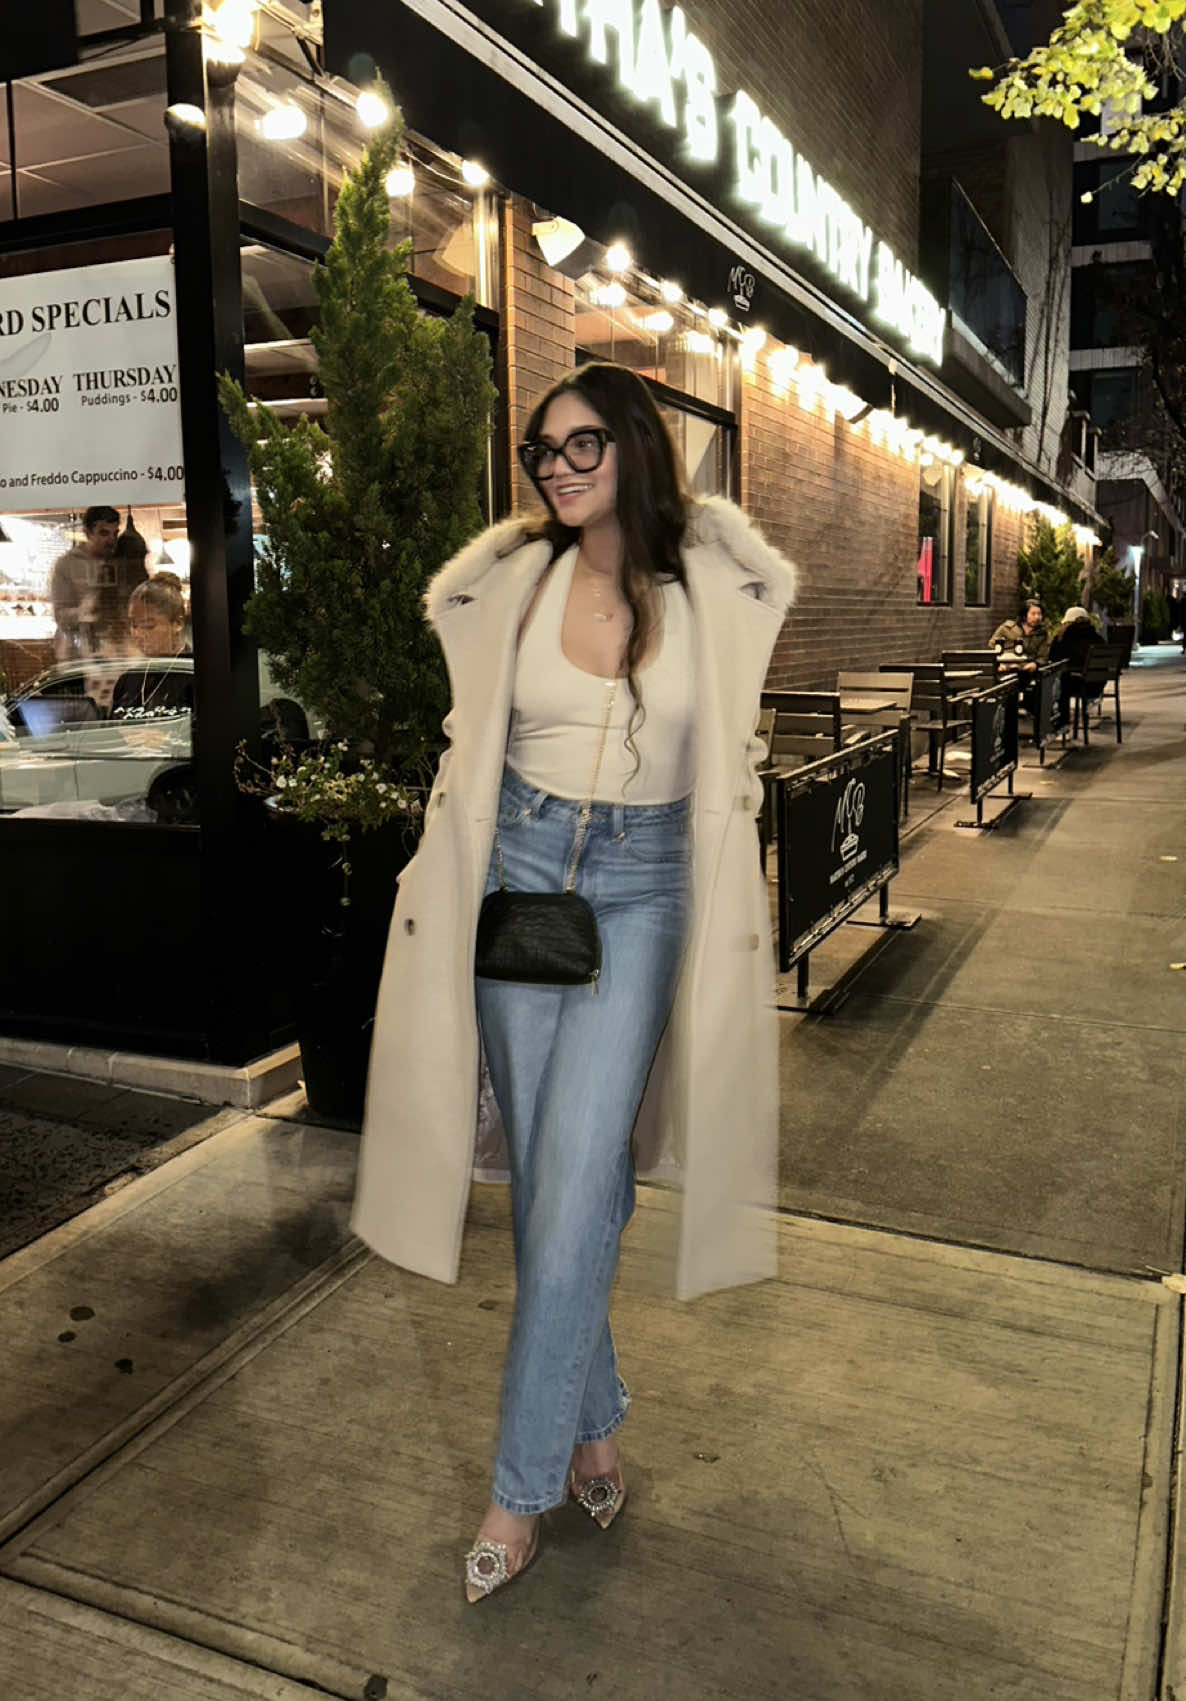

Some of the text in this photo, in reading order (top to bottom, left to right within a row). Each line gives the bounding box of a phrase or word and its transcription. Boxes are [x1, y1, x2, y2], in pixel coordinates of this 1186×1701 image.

[727, 88, 873, 301] COUNTRY
[31, 290, 171, 328] SPECIALS
[73, 364, 176, 391] THURSDAY
[27, 397, 59, 413] $4.00
[81, 393, 131, 407] Puddings
[140, 387, 178, 403] $4.00
[9, 473, 28, 487] and
[31, 469, 69, 485] Freddo
[71, 466, 138, 485] Cappuccino
[147, 464, 184, 482] $4.00
